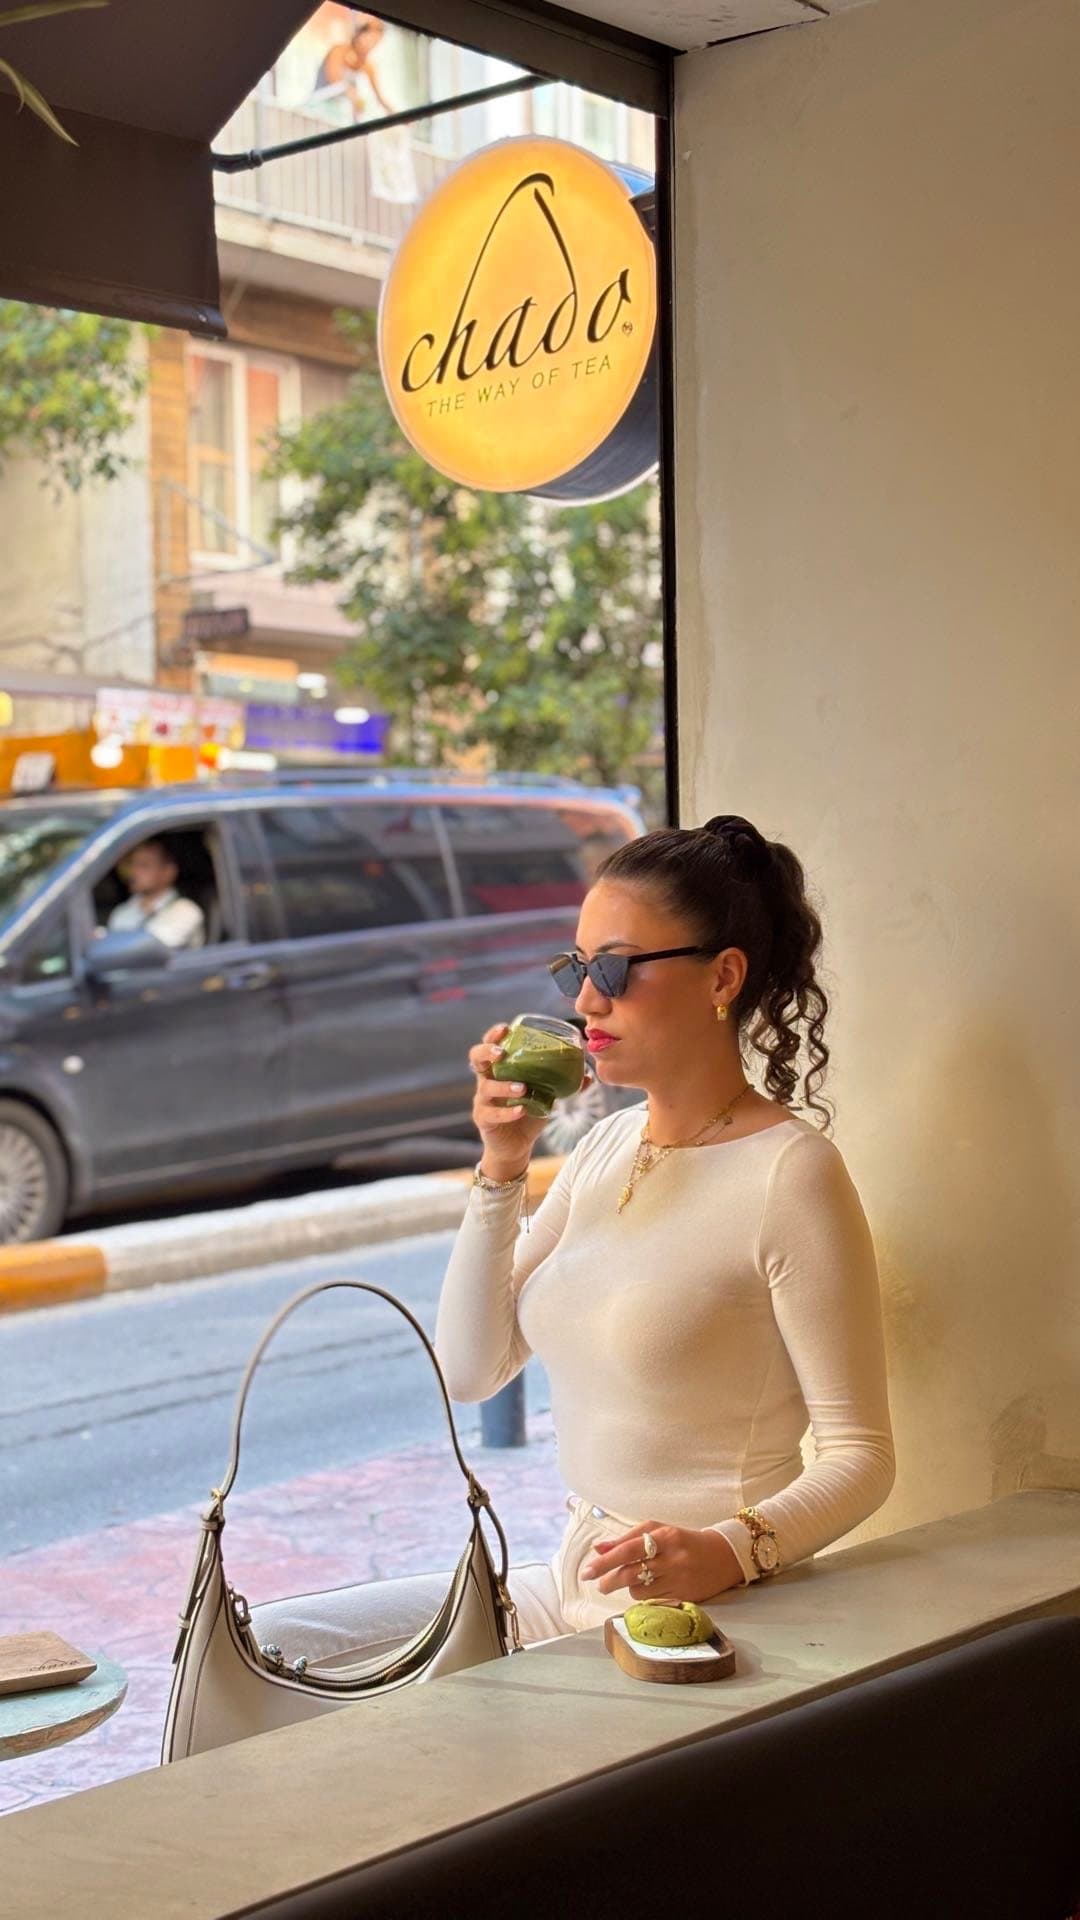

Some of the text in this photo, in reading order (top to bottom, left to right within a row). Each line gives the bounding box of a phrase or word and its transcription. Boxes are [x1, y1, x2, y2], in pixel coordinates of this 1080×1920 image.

[401, 172, 631, 393] chado
[426, 354, 612, 418] THE WAY OF TEA
